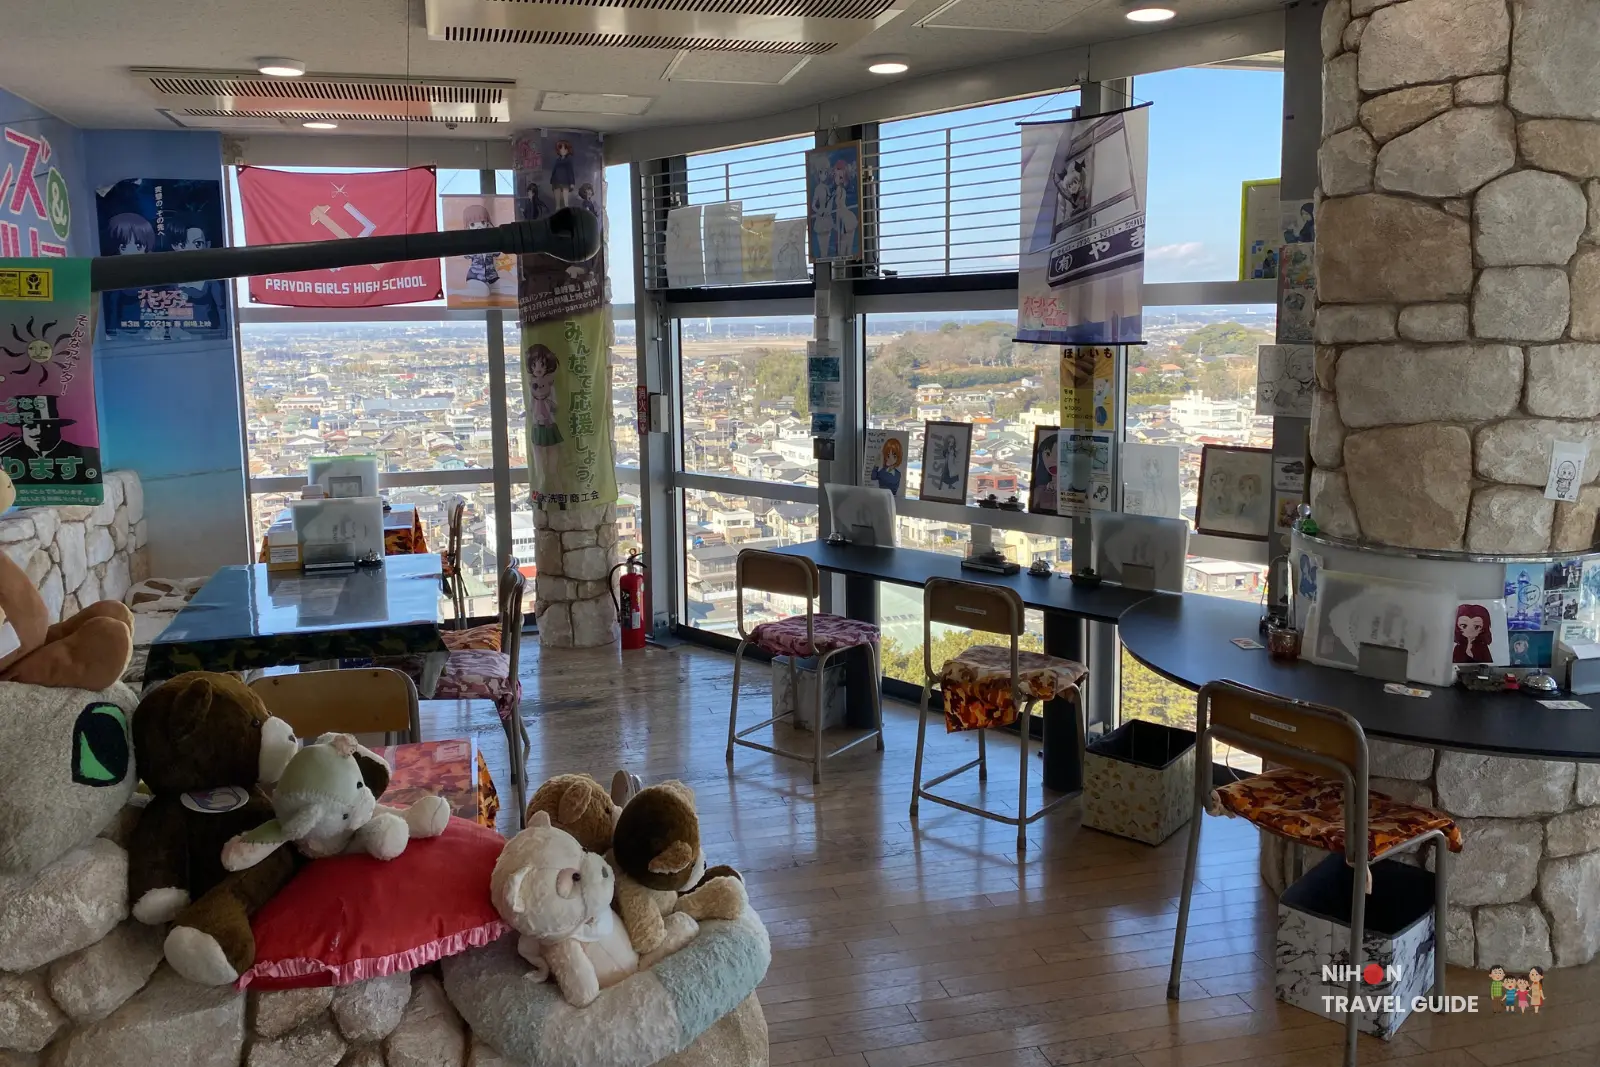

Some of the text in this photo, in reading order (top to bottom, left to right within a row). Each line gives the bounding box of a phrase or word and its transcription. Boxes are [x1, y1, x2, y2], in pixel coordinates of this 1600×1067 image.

[265, 278, 313, 293] PRAVDA
[353, 280, 380, 294] HIGH
[382, 275, 427, 291] SCHOOL
[1064, 348, 1113, 359] ほしいも
[564, 321, 597, 489] みんなで応援しよう!
[637, 387, 647, 423] 消火器
[537, 490, 600, 504] 大洗町商工会
